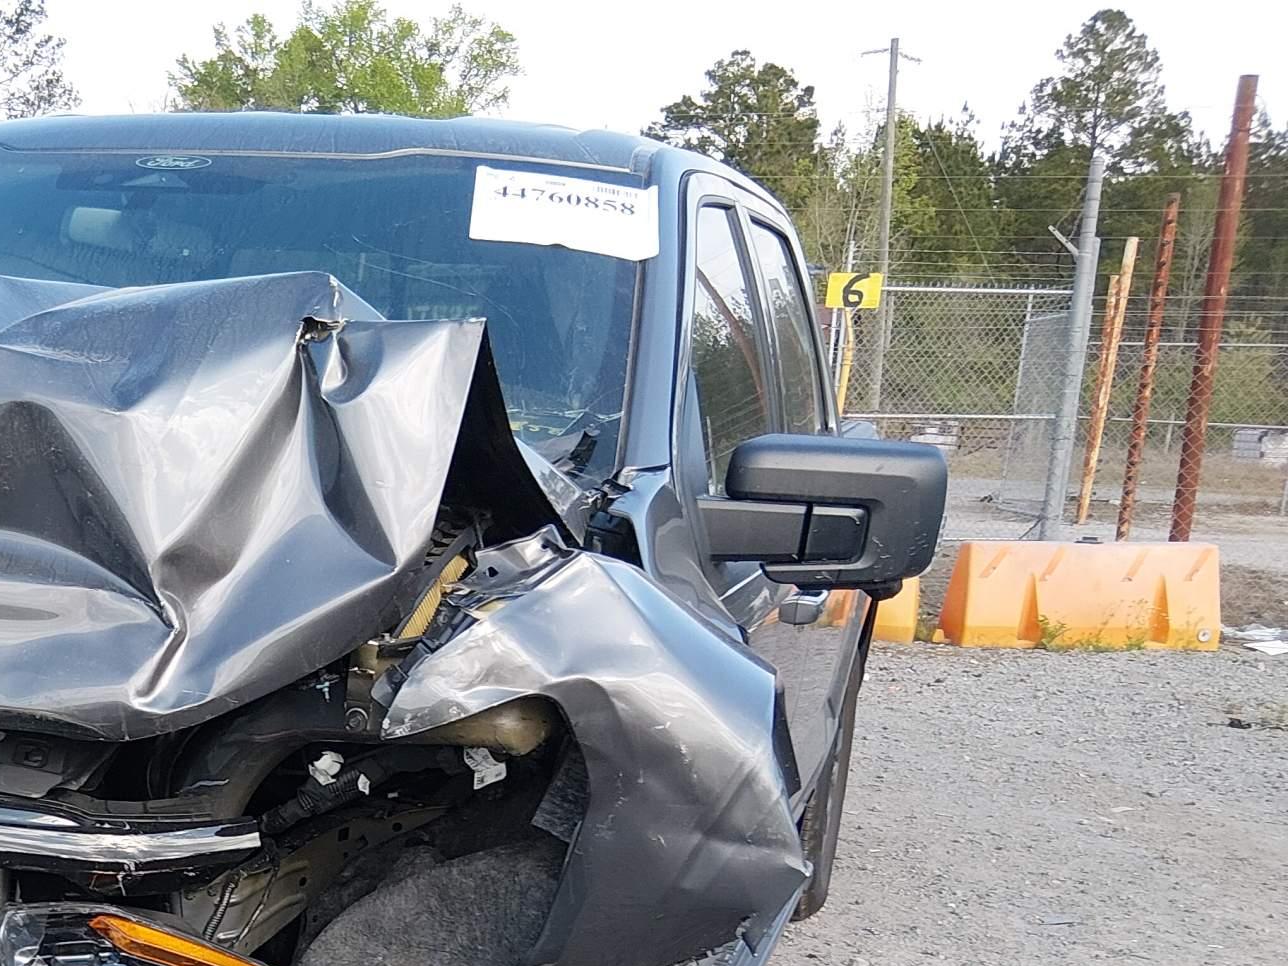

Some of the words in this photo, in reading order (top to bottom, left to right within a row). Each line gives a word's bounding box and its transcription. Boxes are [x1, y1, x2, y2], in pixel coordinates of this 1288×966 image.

[146, 155, 201, 168] Ford
[492, 184, 636, 216] 44760858
[842, 271, 871, 307] 6
